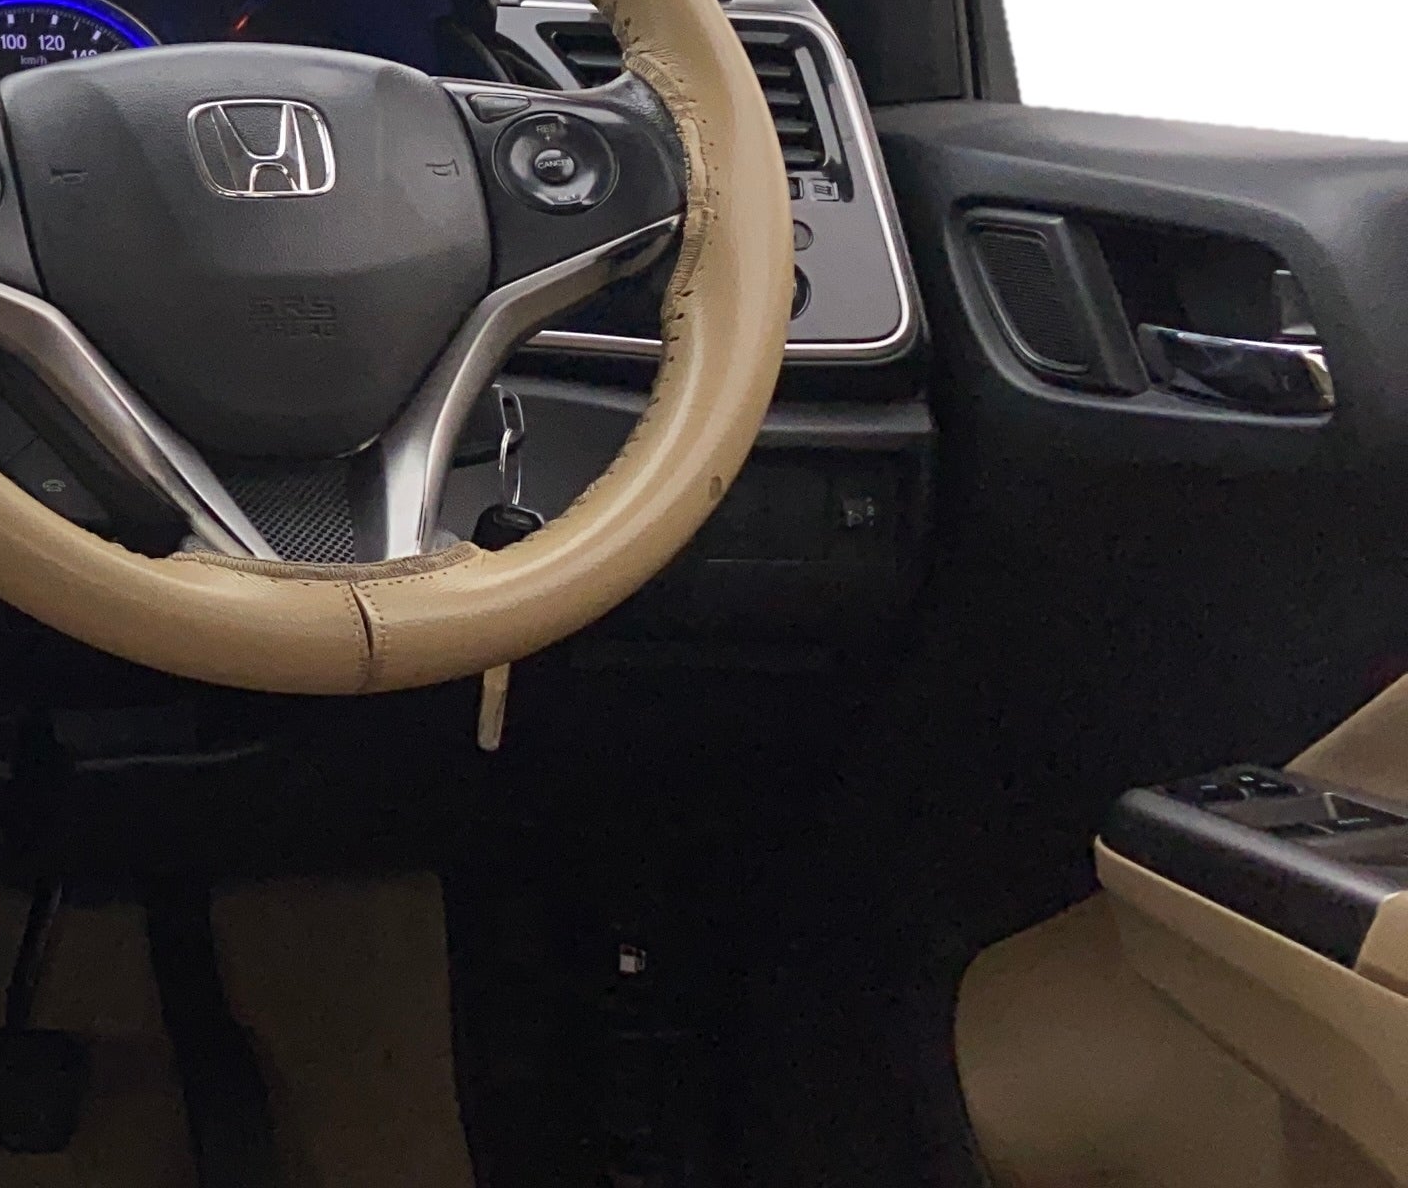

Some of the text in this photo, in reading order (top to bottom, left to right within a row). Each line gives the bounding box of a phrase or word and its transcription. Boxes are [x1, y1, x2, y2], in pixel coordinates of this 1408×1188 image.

[0, 34, 27, 50] 100
[38, 35, 65, 51] 120
[20, 55, 48, 65] km/h
